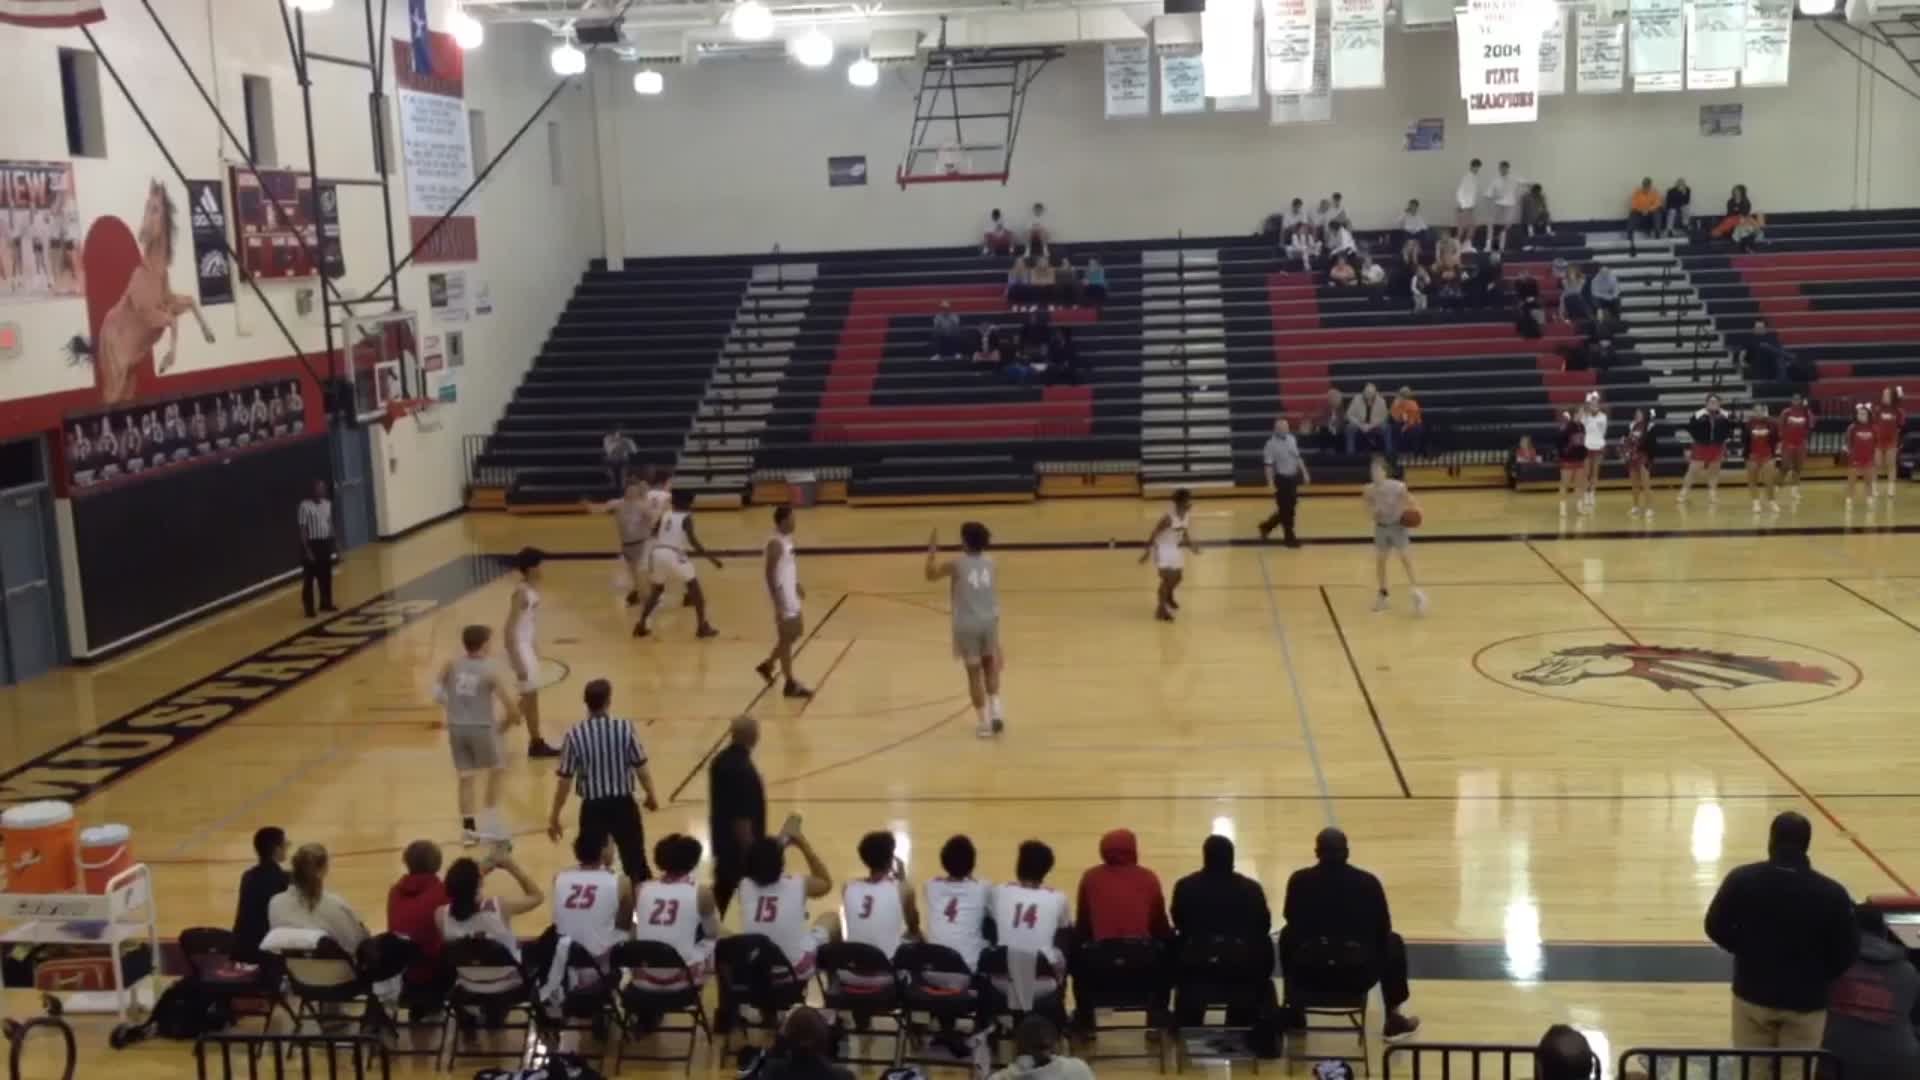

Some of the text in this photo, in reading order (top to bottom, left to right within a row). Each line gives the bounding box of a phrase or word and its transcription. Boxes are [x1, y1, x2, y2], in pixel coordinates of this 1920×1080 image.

[1483, 43, 1521, 59] 2004
[1485, 66, 1519, 85] STATE
[1470, 90, 1535, 111] CHAMPIONS
[564, 884, 598, 910] 25
[754, 895, 779, 924] 15
[858, 894, 875, 919] 3
[943, 896, 959, 924] 4
[648, 898, 680, 925] 23
[1013, 902, 1038, 929] 14
